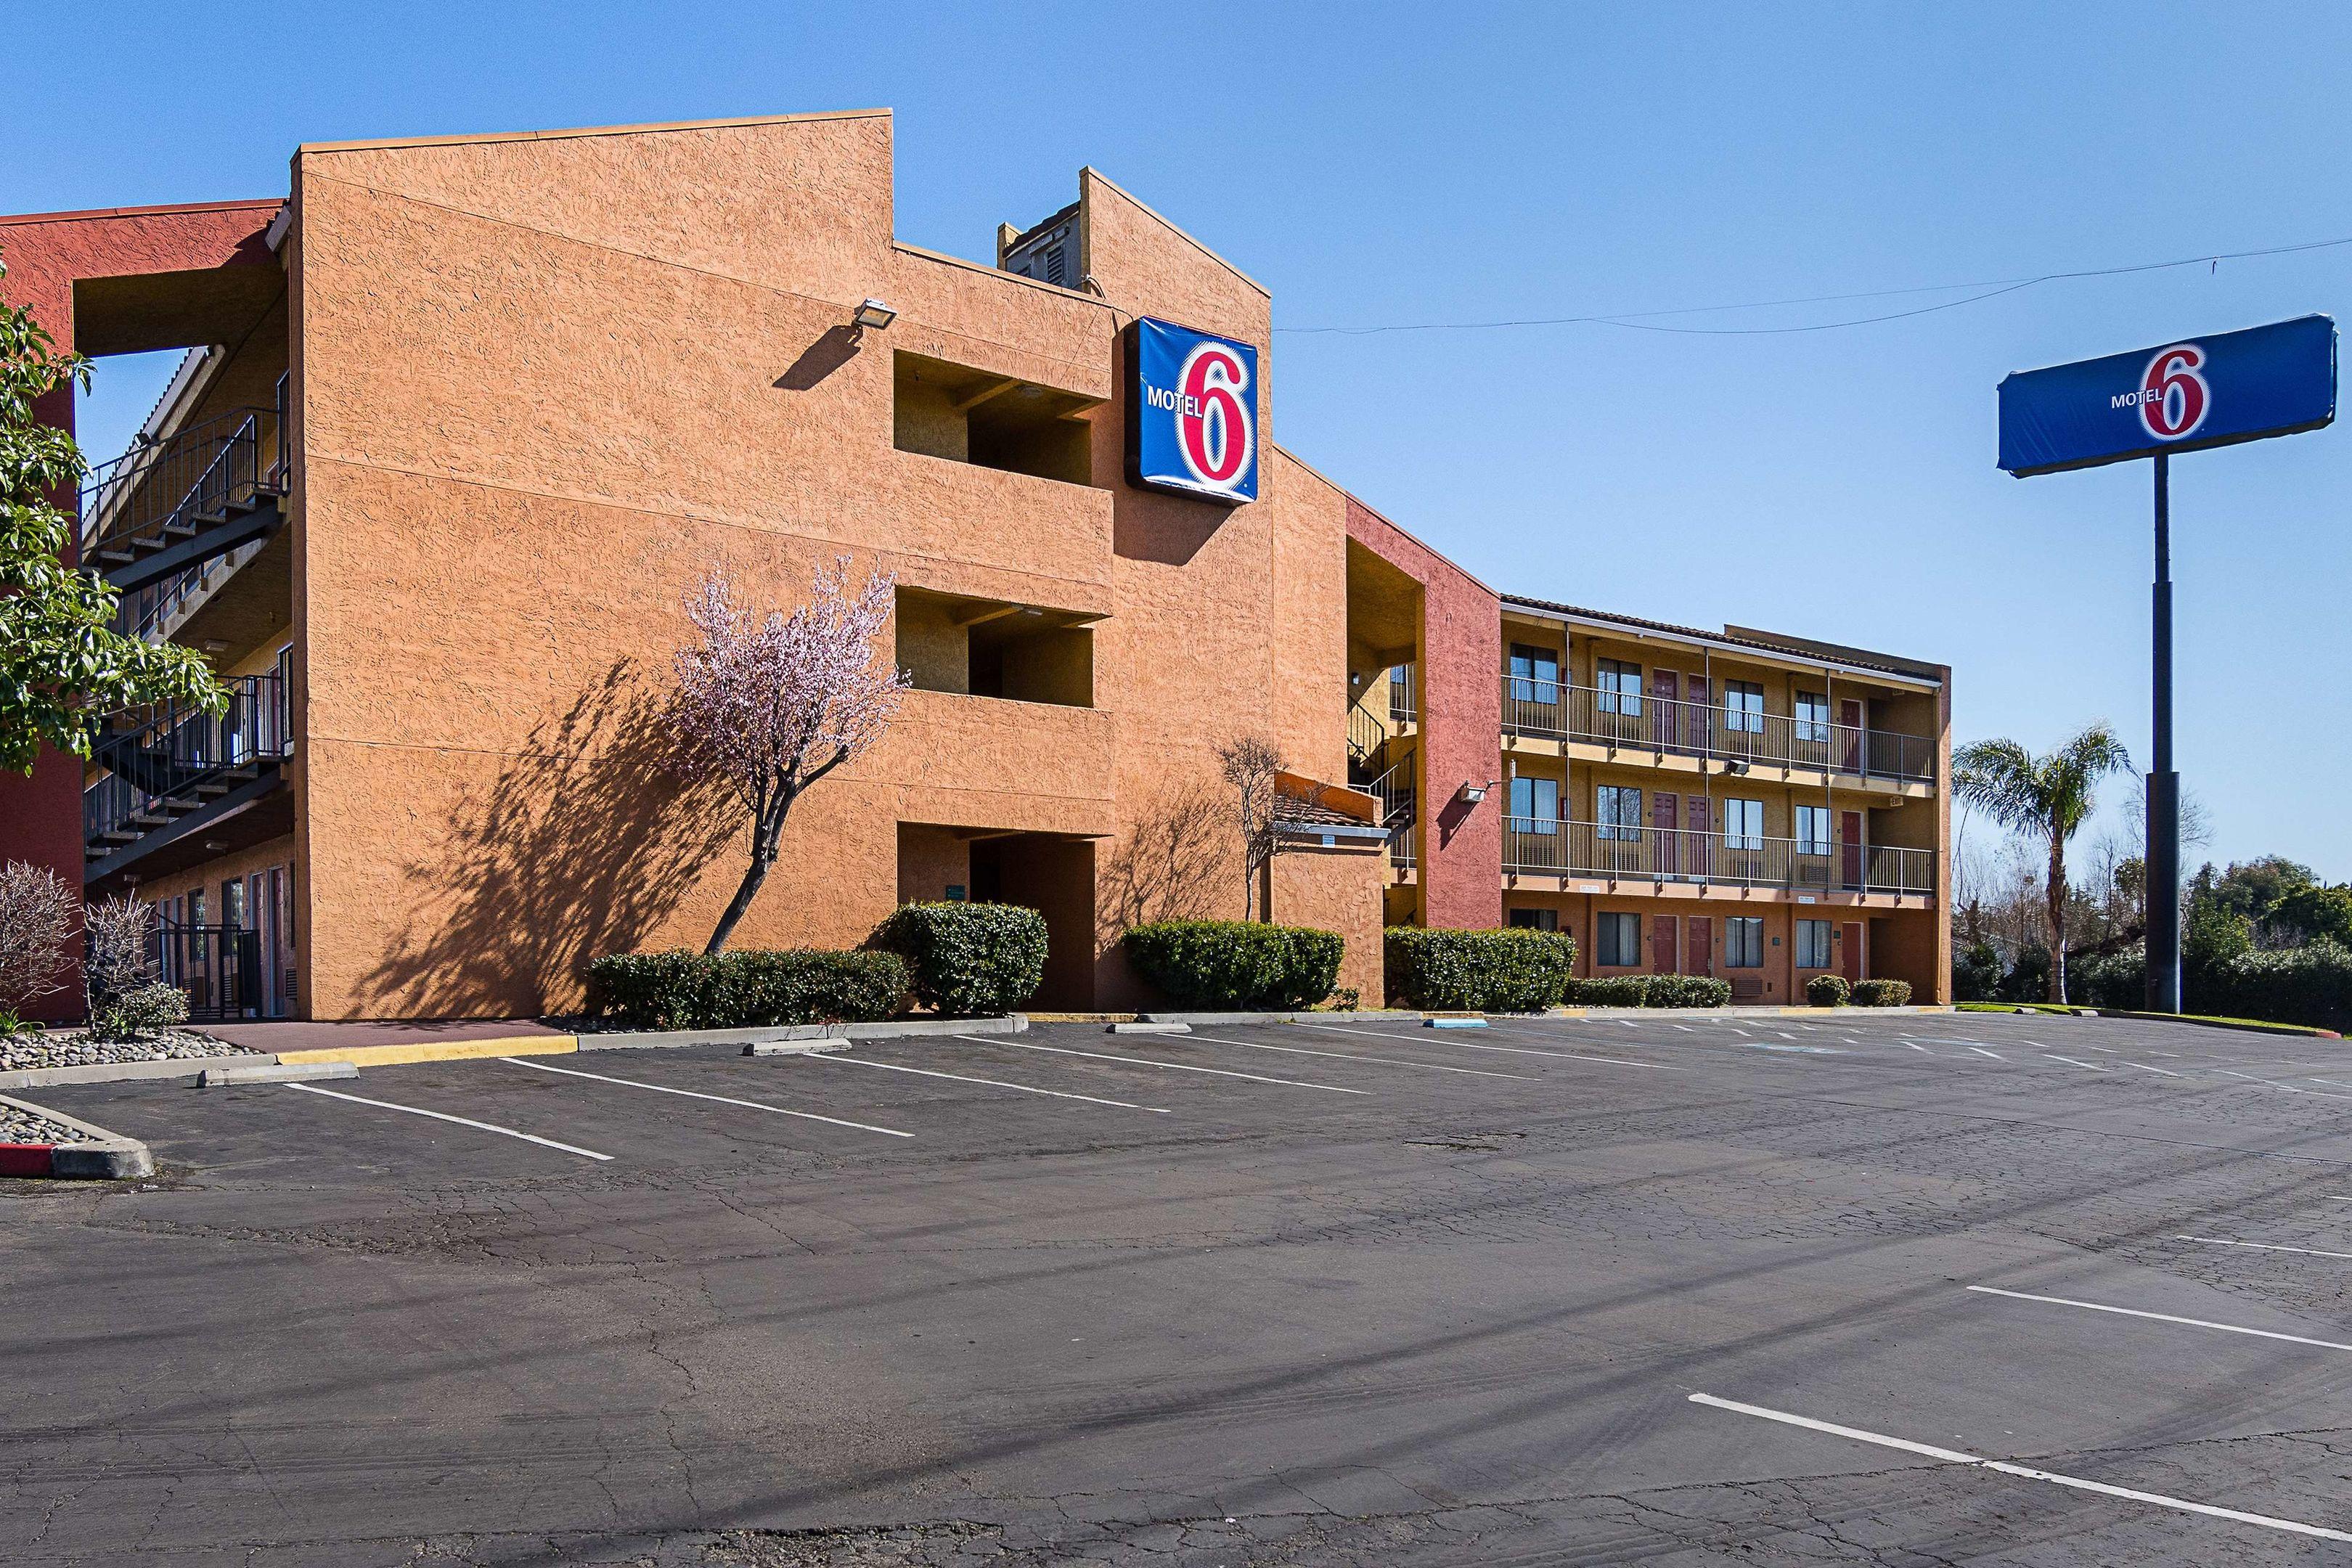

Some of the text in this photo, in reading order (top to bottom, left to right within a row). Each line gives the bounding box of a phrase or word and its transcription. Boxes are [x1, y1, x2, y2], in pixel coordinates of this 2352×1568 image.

[1147, 351, 1246, 481] MOTEL 6
[2111, 349, 2204, 436] MOTEL 6
